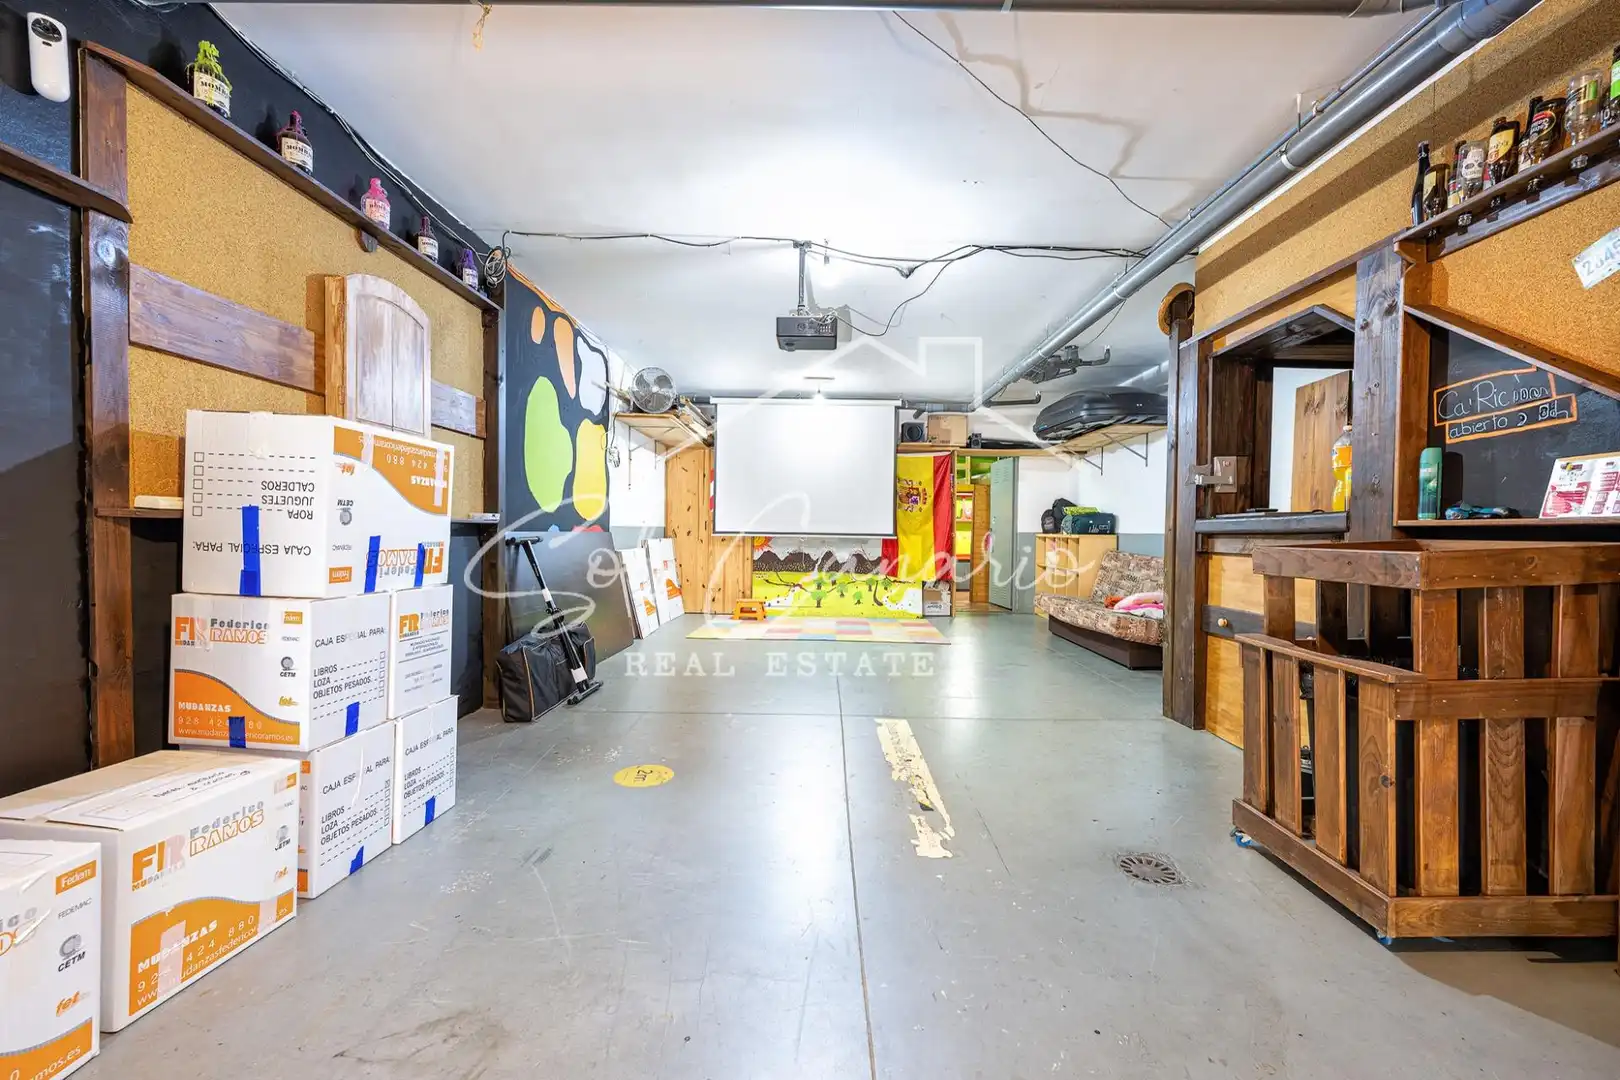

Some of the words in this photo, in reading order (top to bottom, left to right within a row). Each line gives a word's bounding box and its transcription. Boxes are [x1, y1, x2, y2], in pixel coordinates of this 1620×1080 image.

[1449, 412, 1508, 439] abierto
[386, 454, 405, 466] 880
[412, 459, 428, 469] 424
[260, 480, 315, 492] CALDEROS
[410, 475, 448, 489] MANZAS
[261, 494, 315, 506] JUGUETES
[337, 499, 354, 507] CETM
[287, 509, 314, 520] ROPA
[284, 544, 312, 556] CAJA
[378, 565, 417, 578] Federi
[209, 628, 267, 645] RAMOS
[314, 636, 334, 648] CAJA
[313, 664, 338, 677] LIBROS
[313, 676, 331, 688] LOZA
[312, 684, 343, 700] OBJETOS
[178, 701, 232, 713] MUDANZAS
[178, 716, 200, 726] 928
[404, 744, 419, 756] CAJA
[403, 766, 422, 781] LIBROS
[322, 780, 342, 795] CAJA
[403, 778, 417, 791] LOZA
[403, 781, 425, 800] OBJETOS
[189, 800, 264, 840] Federico
[320, 805, 345, 824] LIBROS
[189, 808, 265, 858] RAMOS
[320, 819, 339, 835] LOZA
[320, 823, 350, 846] OBJETOS
[61, 867, 92, 889] Fedem
[57, 897, 92, 920] FEDEMAC
[185, 938, 216, 963] 424
[227, 914, 255, 937] 880
[57, 950, 86, 973] CETM
